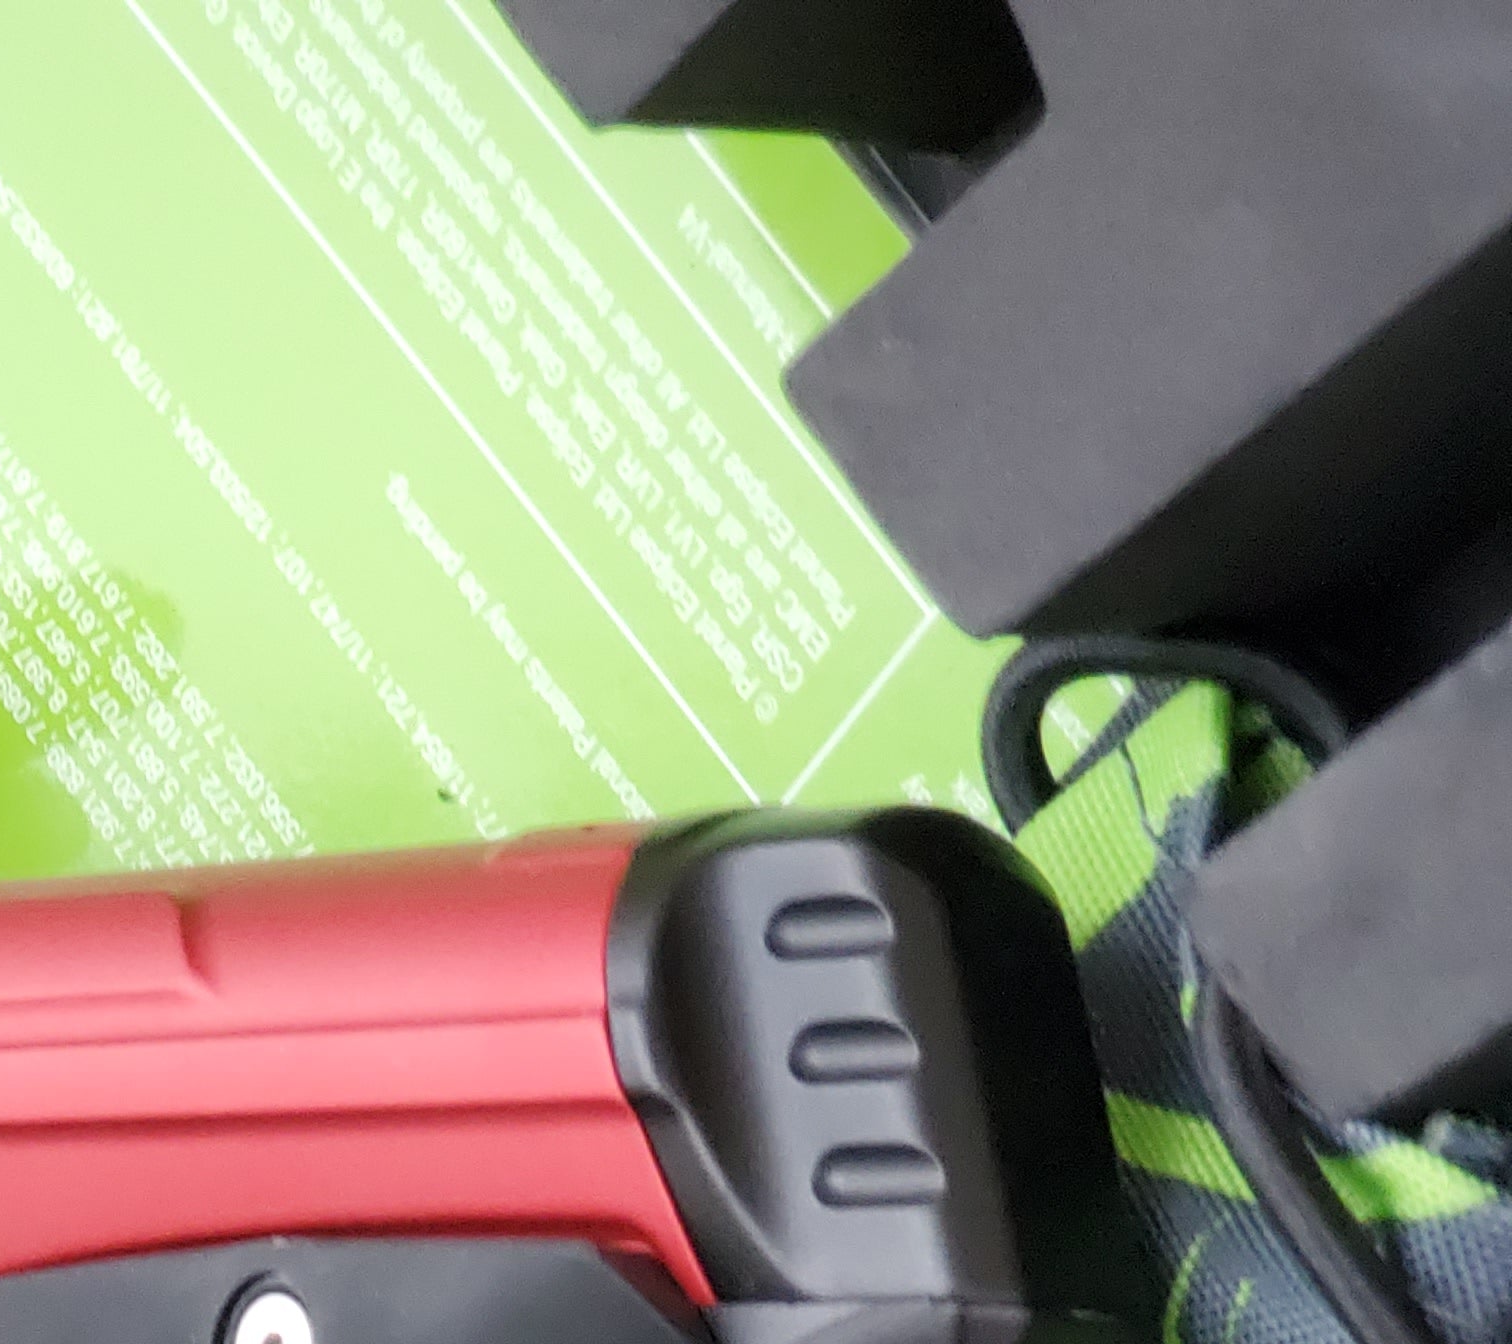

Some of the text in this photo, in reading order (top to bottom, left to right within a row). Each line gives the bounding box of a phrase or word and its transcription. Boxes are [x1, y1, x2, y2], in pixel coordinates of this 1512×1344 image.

[371, 11, 405, 47] of
[403, 43, 483, 142] property
[296, 100, 343, 167] Logo
[478, 139, 512, 182] are
[338, 159, 361, 192] E
[360, 182, 393, 229] the
[512, 180, 612, 314] trademarks
[460, 312, 521, 395] Planet
[611, 312, 661, 373] other
[605, 368, 667, 447] design
[658, 372, 689, 409] All
[724, 453, 794, 547] Eclipse
[458, 571, 487, 612] be
[630, 526, 698, 621] Eclipse
[746, 547, 780, 588] are
[790, 540, 854, 628] Planet
[483, 603, 528, 662] may
[694, 612, 758, 700] Planet
[775, 590, 829, 660] EMC
